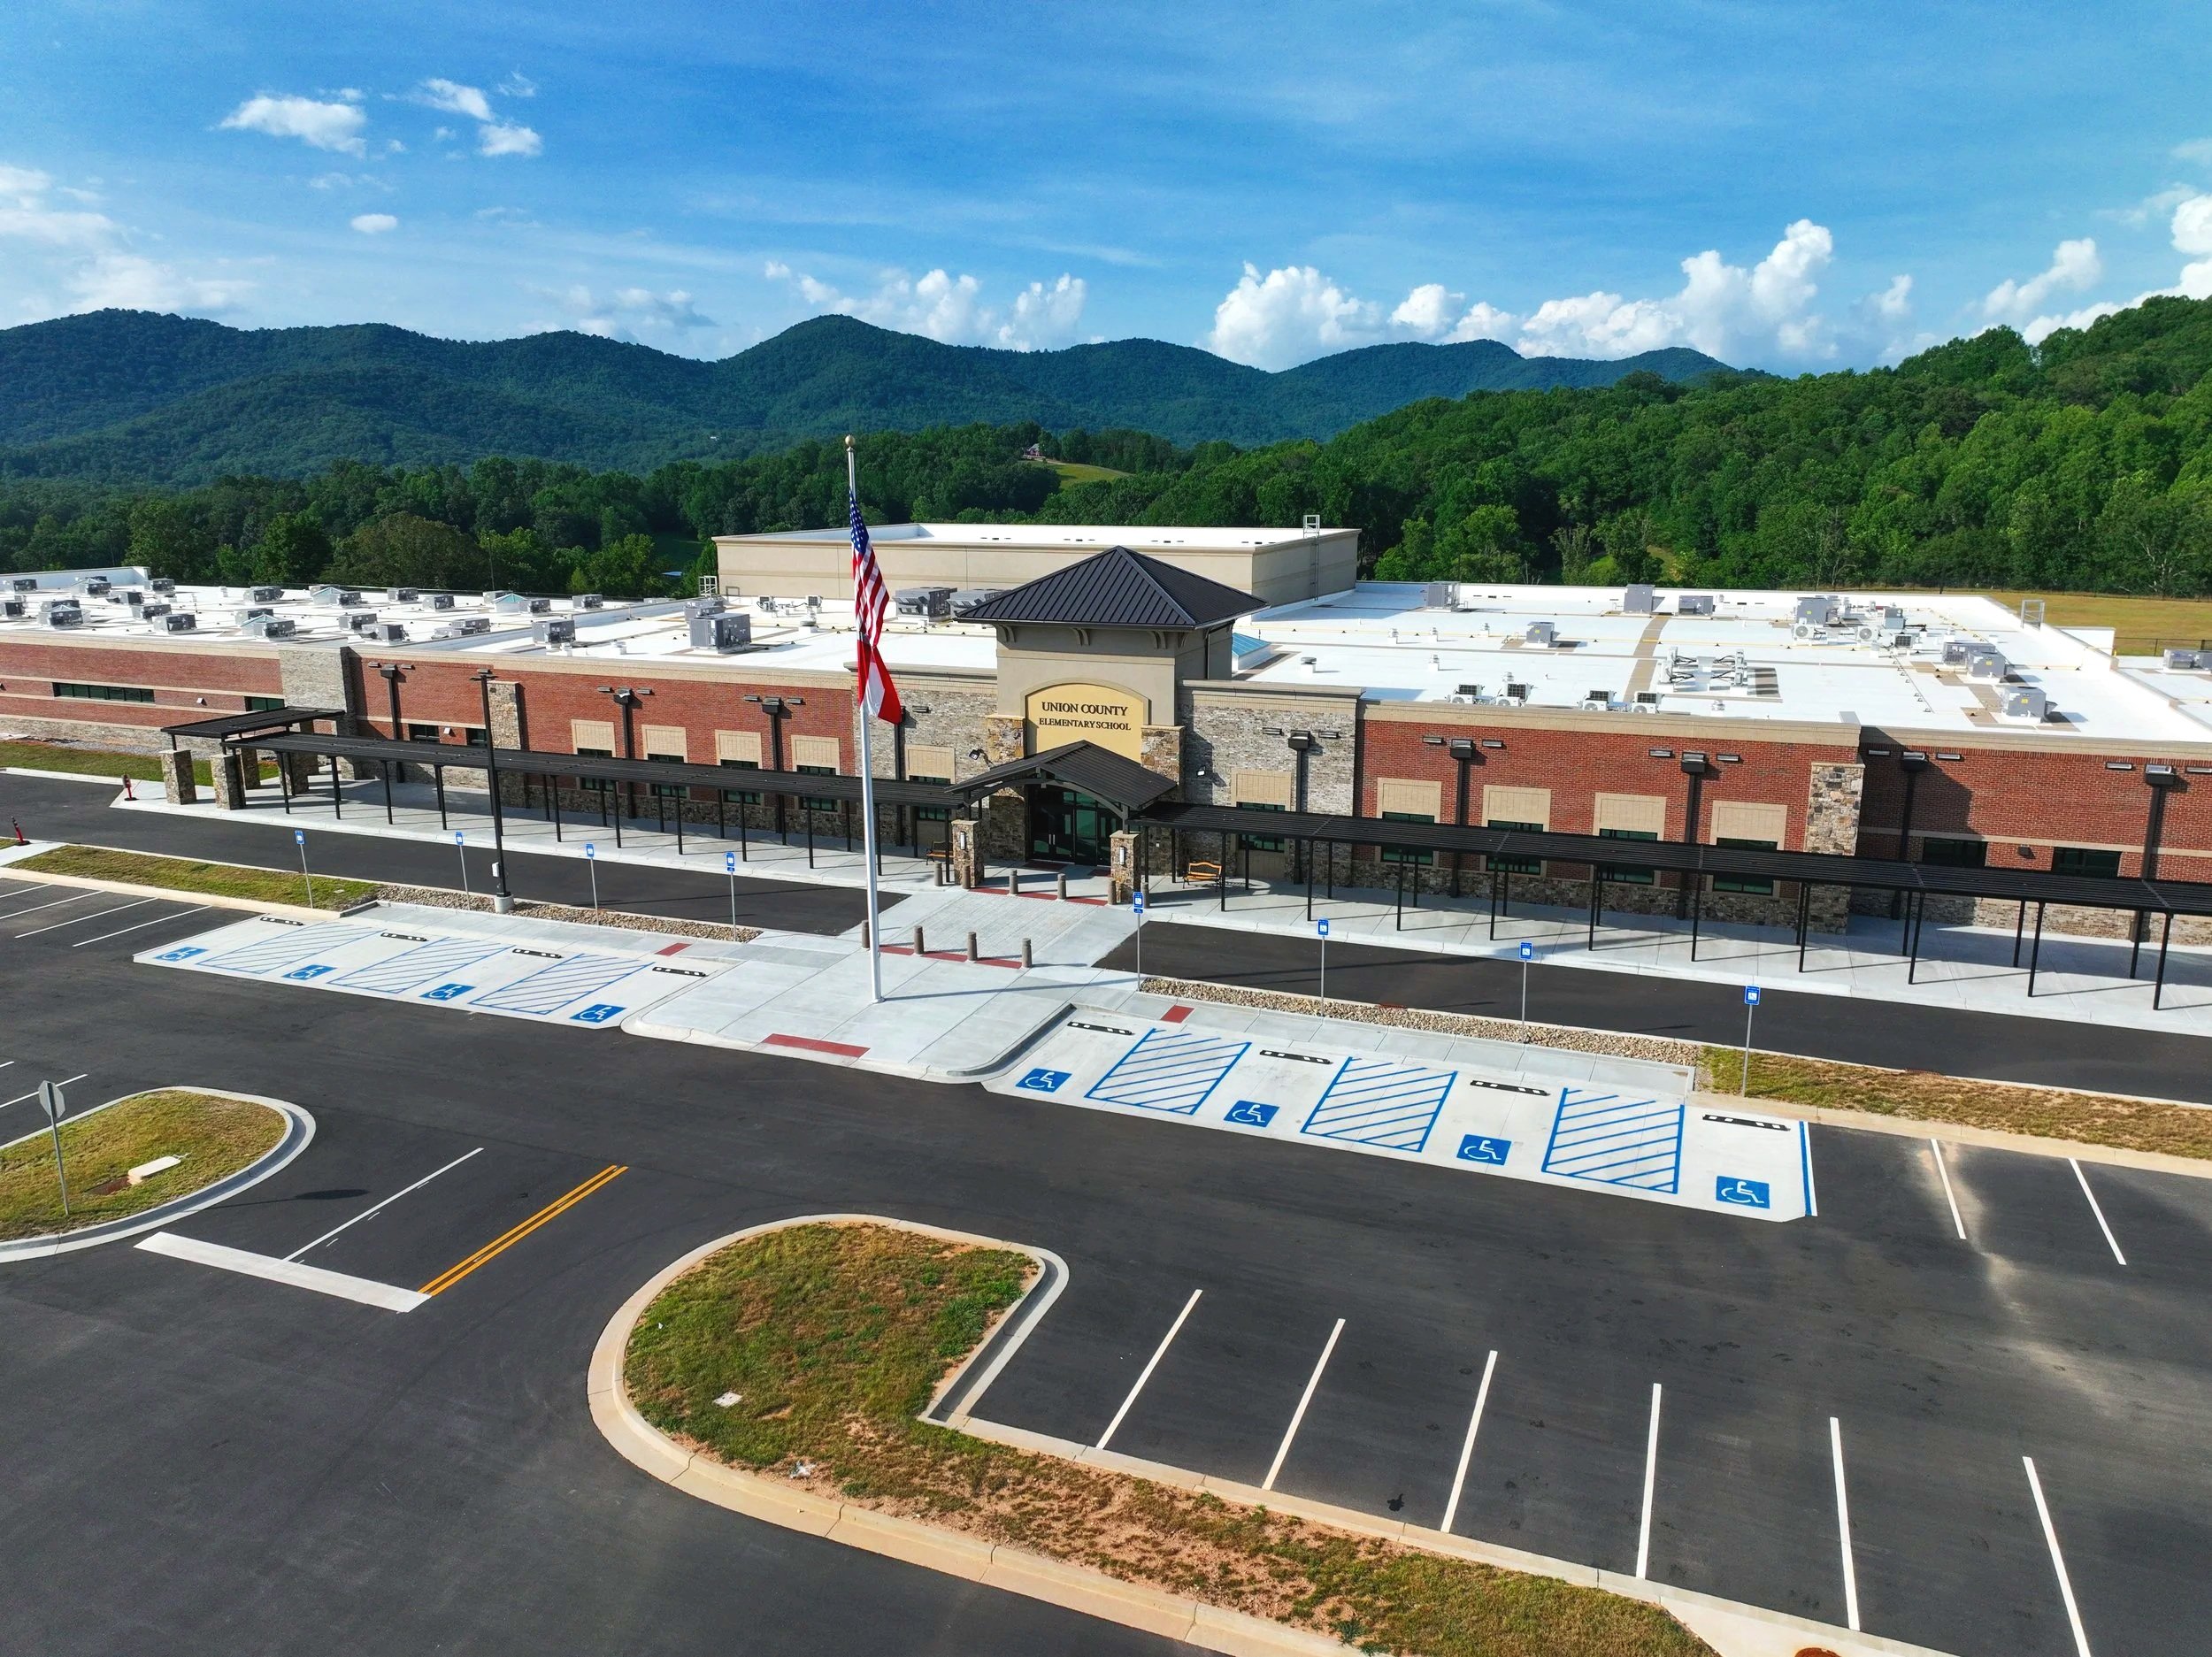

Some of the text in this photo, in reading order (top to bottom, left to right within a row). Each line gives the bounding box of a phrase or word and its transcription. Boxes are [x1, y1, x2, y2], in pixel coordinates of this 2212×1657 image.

[1041, 702, 1128, 716] UNION COUNTY
[1039, 717, 1132, 731] ELEMENTARY SCHOOL
